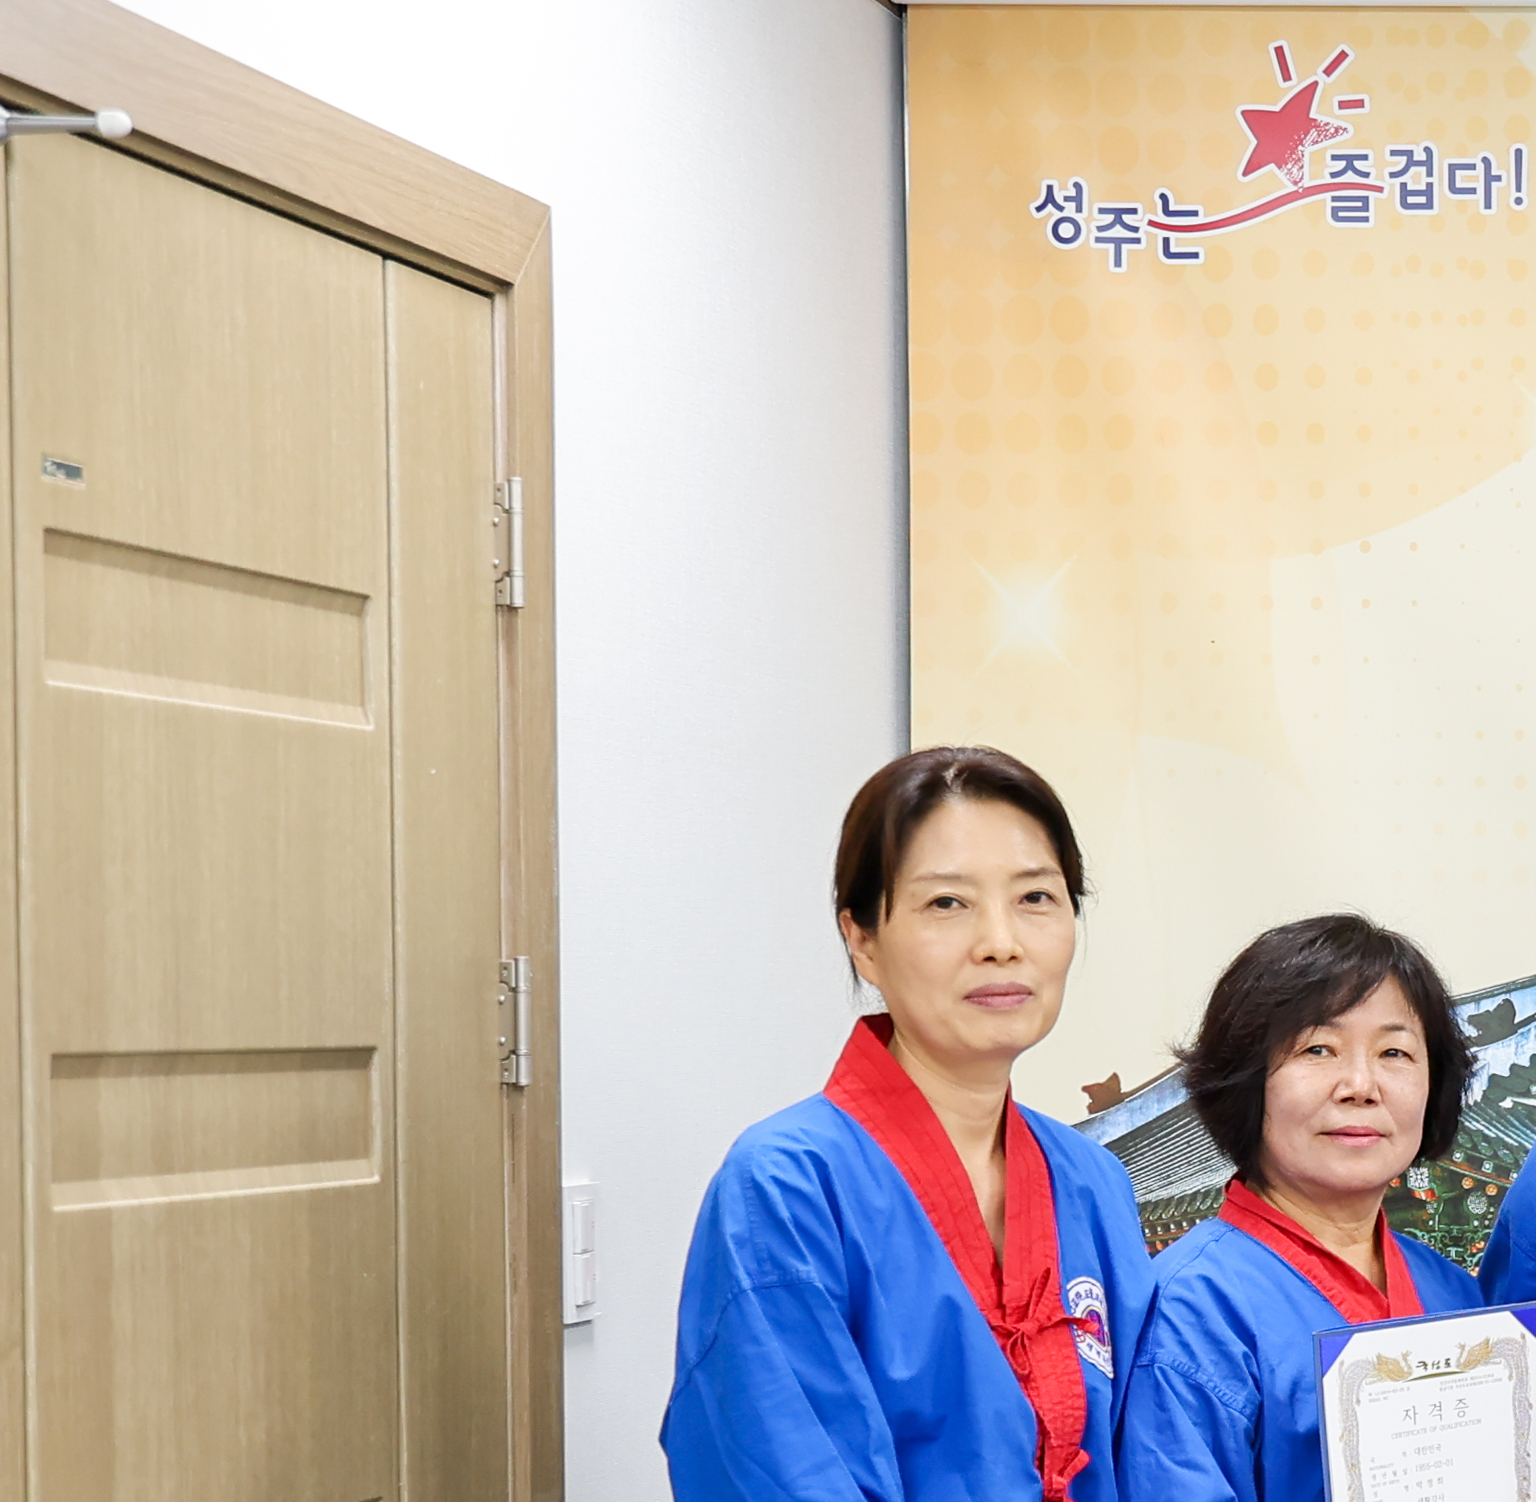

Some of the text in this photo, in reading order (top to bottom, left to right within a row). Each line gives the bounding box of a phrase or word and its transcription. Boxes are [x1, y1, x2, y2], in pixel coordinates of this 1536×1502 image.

[1034, 146, 1524, 268] 성주는 즐겁다!
[1391, 1428, 1427, 1440] CERTIFICATE
[1439, 1417, 1481, 1431] QUALIFICATION
